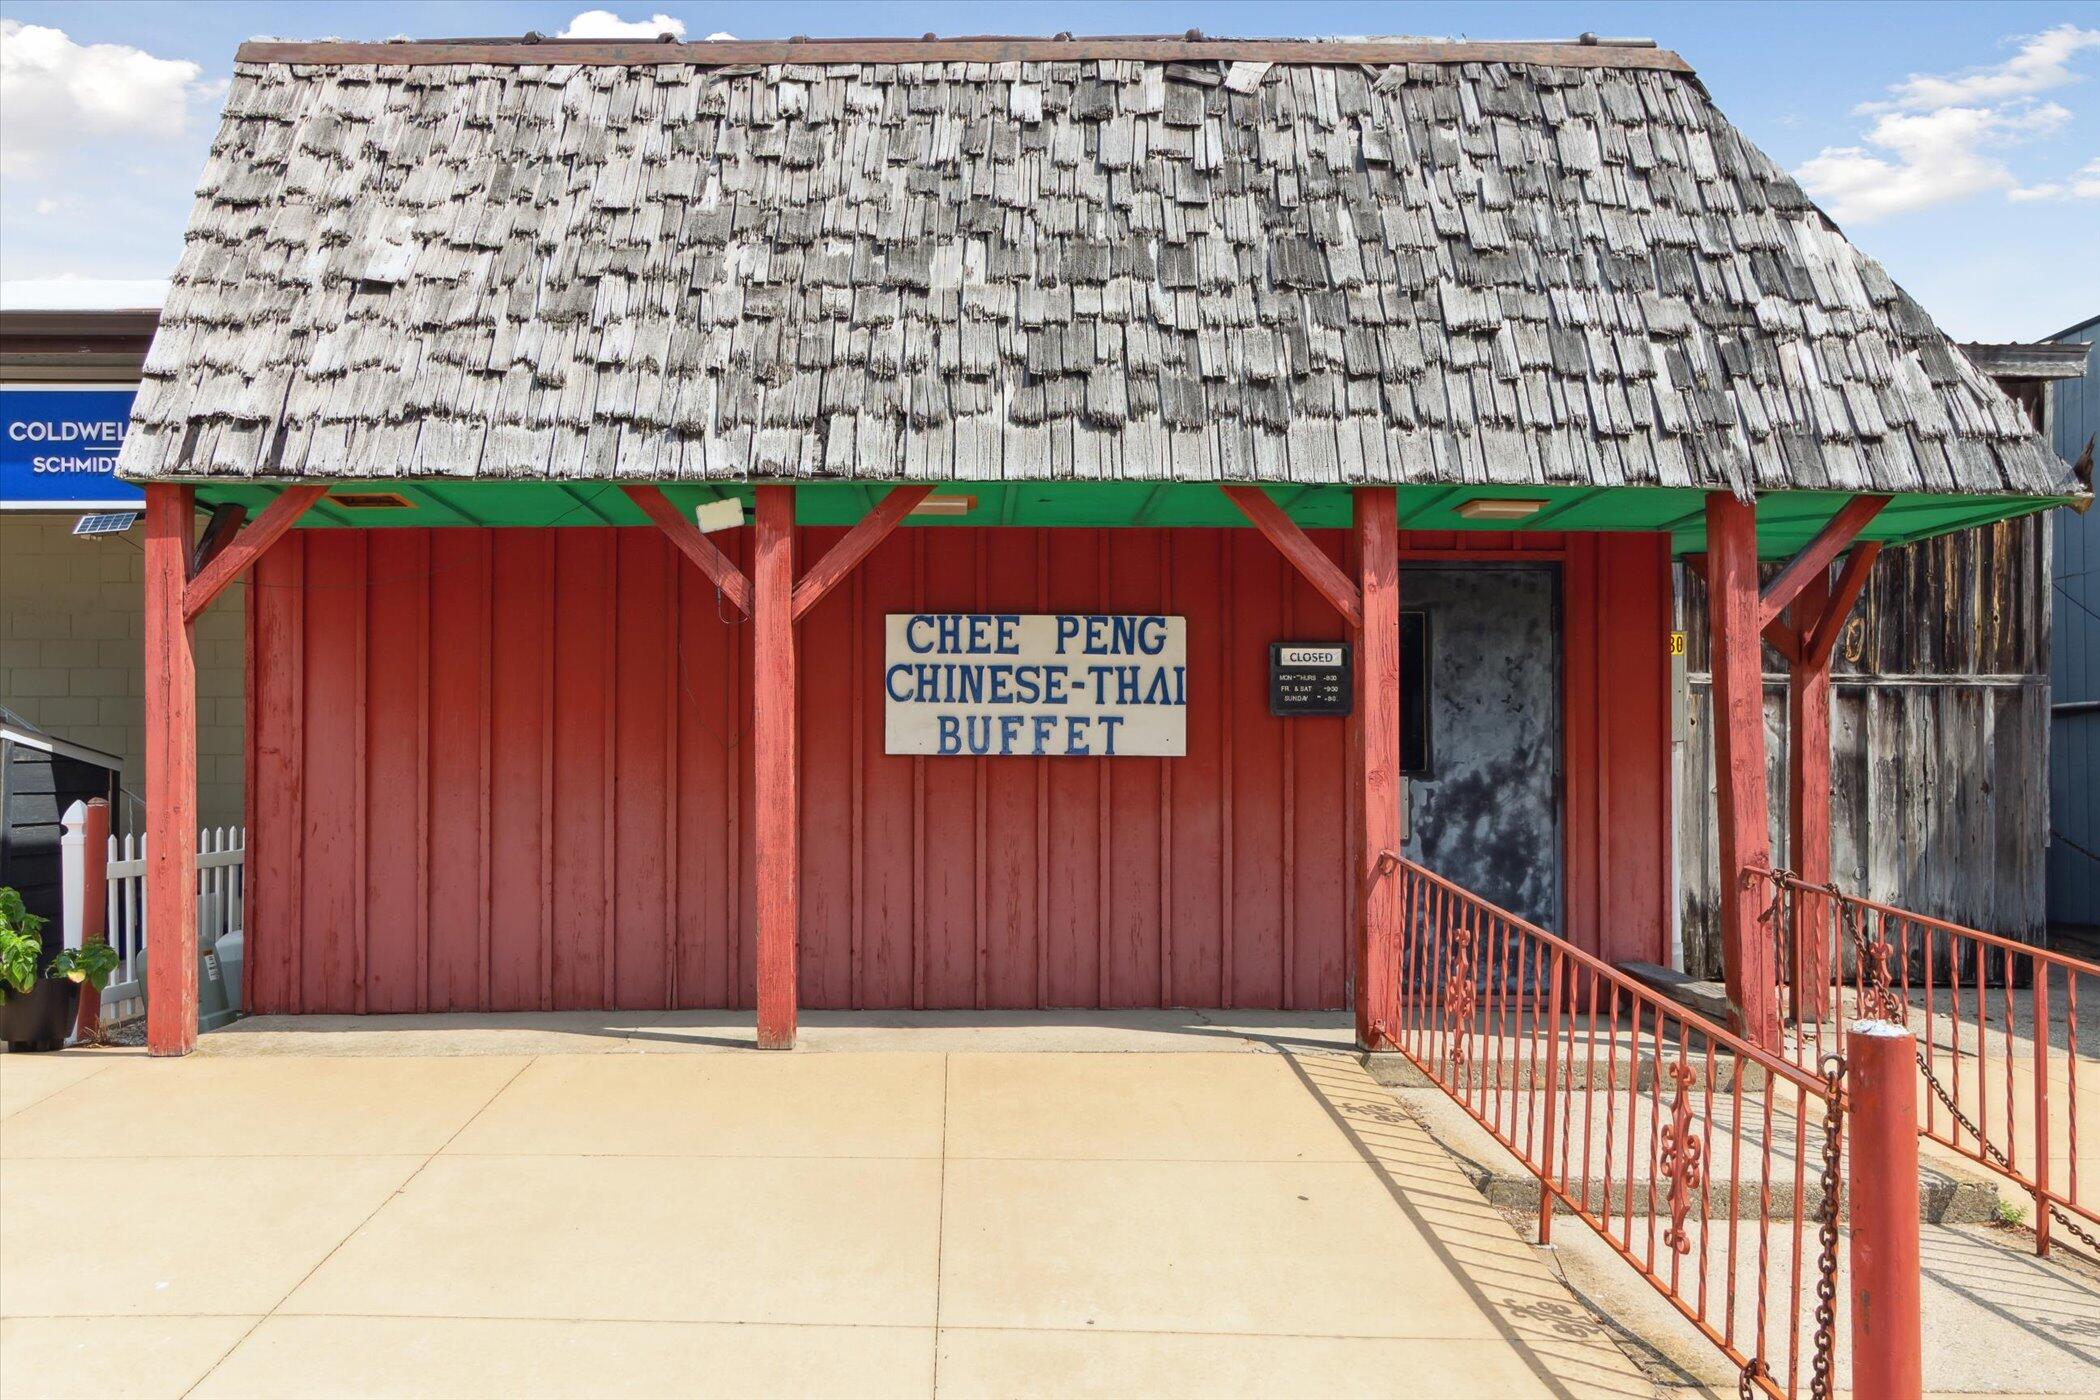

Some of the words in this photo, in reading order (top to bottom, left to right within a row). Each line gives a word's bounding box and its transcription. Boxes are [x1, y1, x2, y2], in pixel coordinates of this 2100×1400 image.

[33, 456, 119, 473] SCHMIDT
[906, 615, 1020, 655] CHEE
[1055, 615, 1167, 655] PENG
[1290, 652, 1333, 662] CLOSED
[885, 664, 1186, 706] CHINESE-THAI
[937, 715, 1124, 755] BUFFET
